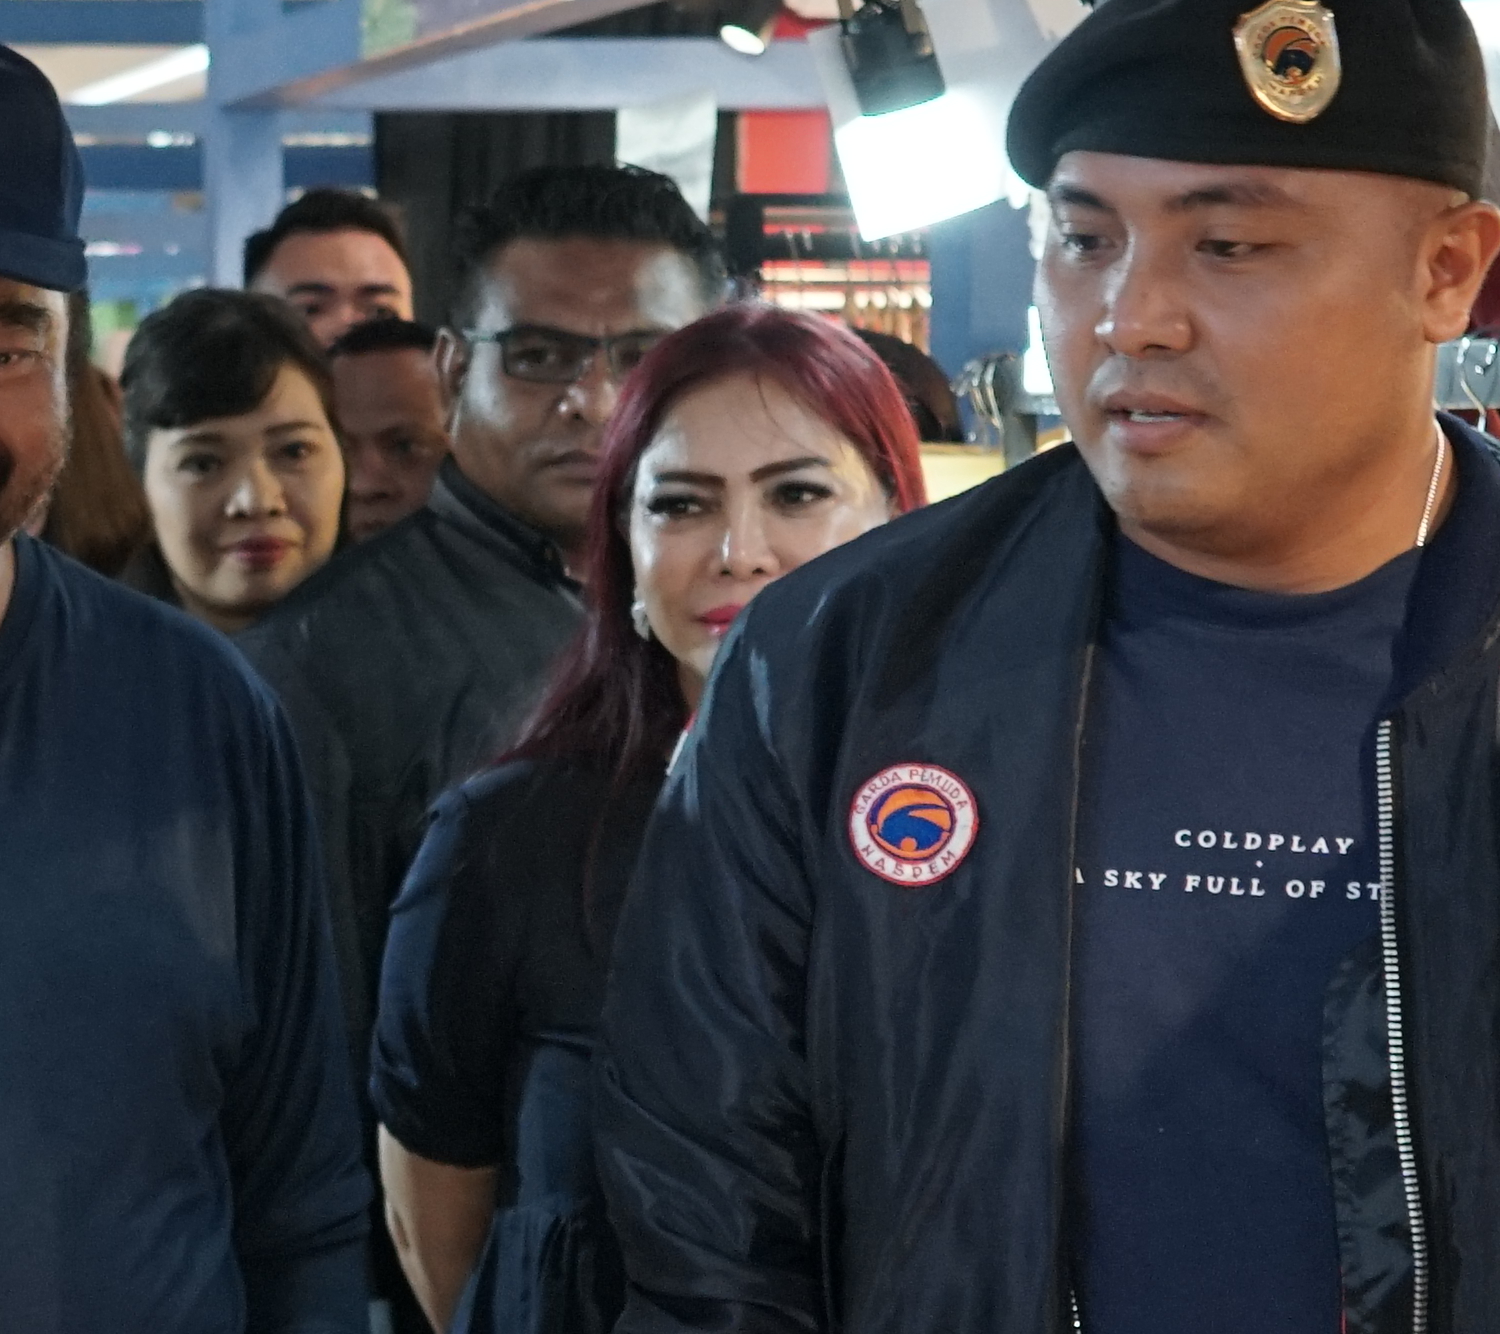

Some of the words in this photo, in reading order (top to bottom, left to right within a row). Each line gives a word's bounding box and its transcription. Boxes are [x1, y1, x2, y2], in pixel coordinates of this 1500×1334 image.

[856, 771, 902, 815] GARDA
[1174, 829, 1355, 855] COLDPLAY
[1103, 869, 1168, 891] SKY
[1184, 875, 1266, 897] FULL
[1285, 879, 1327, 899] OF
